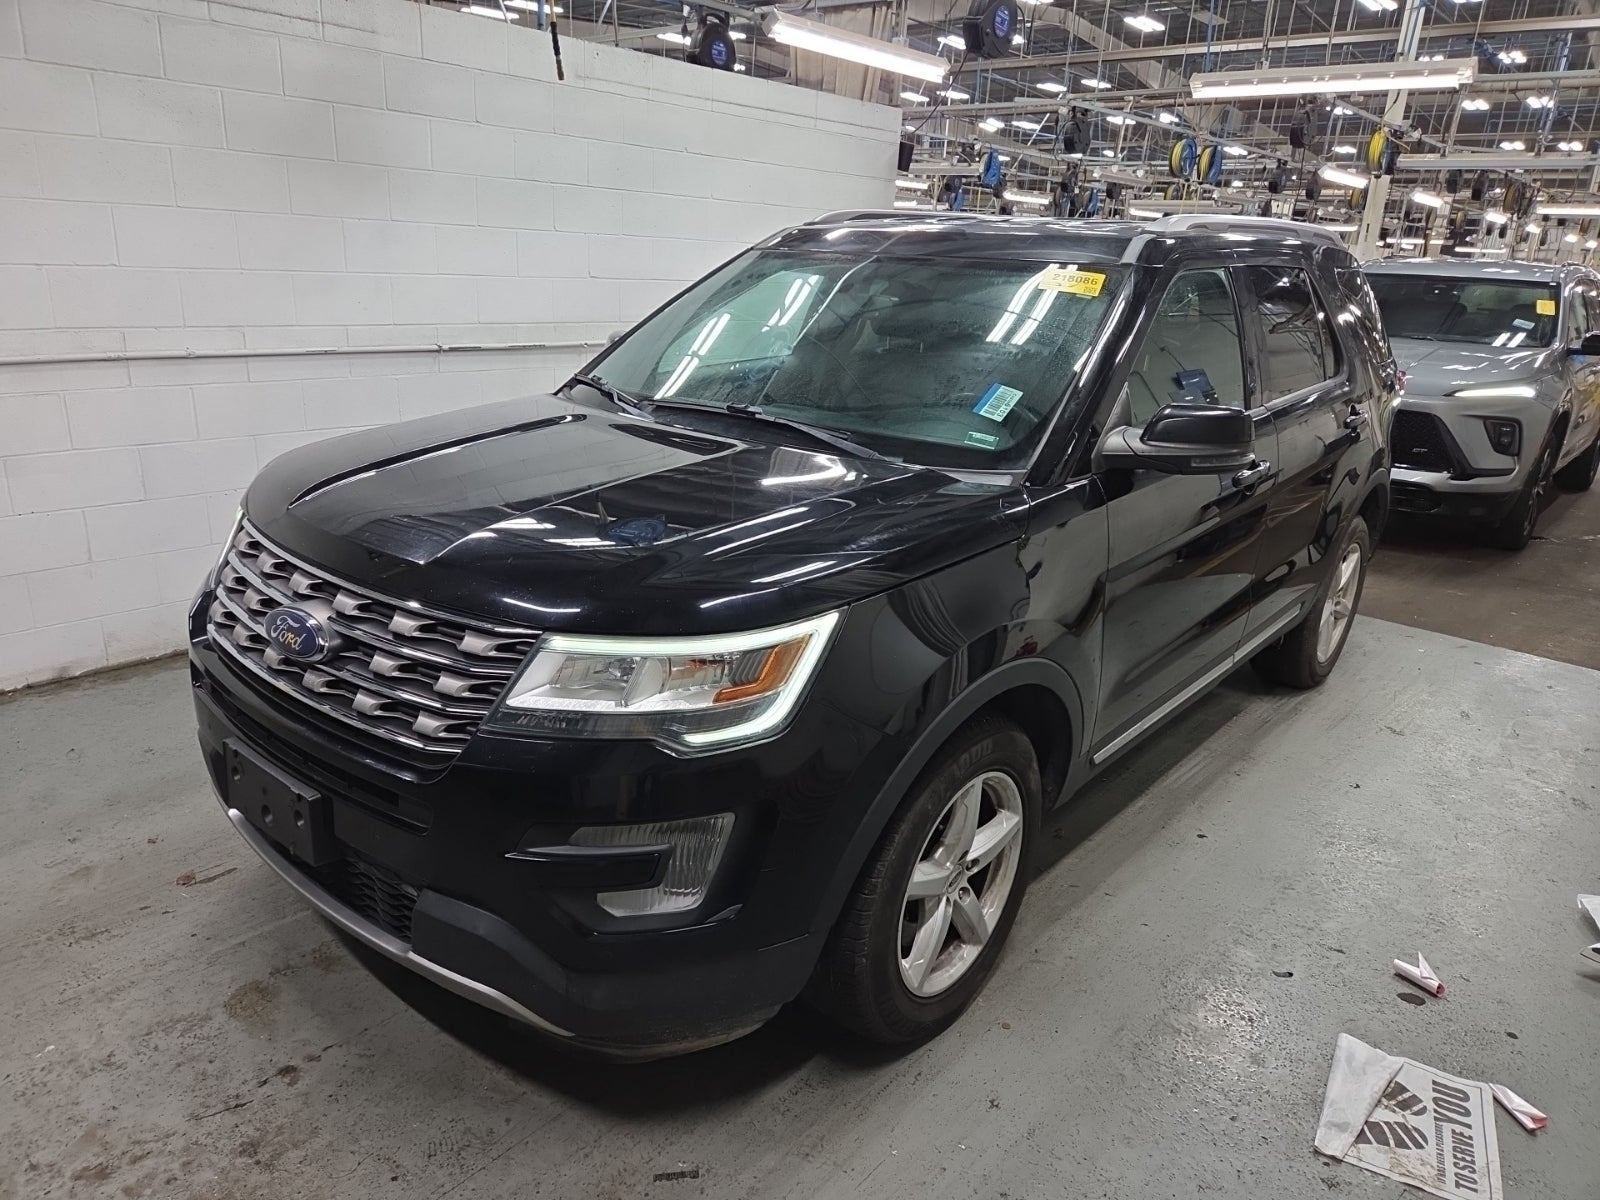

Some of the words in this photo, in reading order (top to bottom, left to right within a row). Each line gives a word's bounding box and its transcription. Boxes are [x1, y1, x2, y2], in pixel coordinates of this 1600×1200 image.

[1052, 273, 1098, 286] 218086
[271, 615, 307, 651] Ford
[1432, 1079, 1472, 1130] YOU
[1435, 1121, 1444, 1148] PLEASURE
[1436, 1152, 1445, 1166] BEEN
[1451, 1128, 1477, 1174] SERVE
[1454, 1172, 1478, 1193] TO
